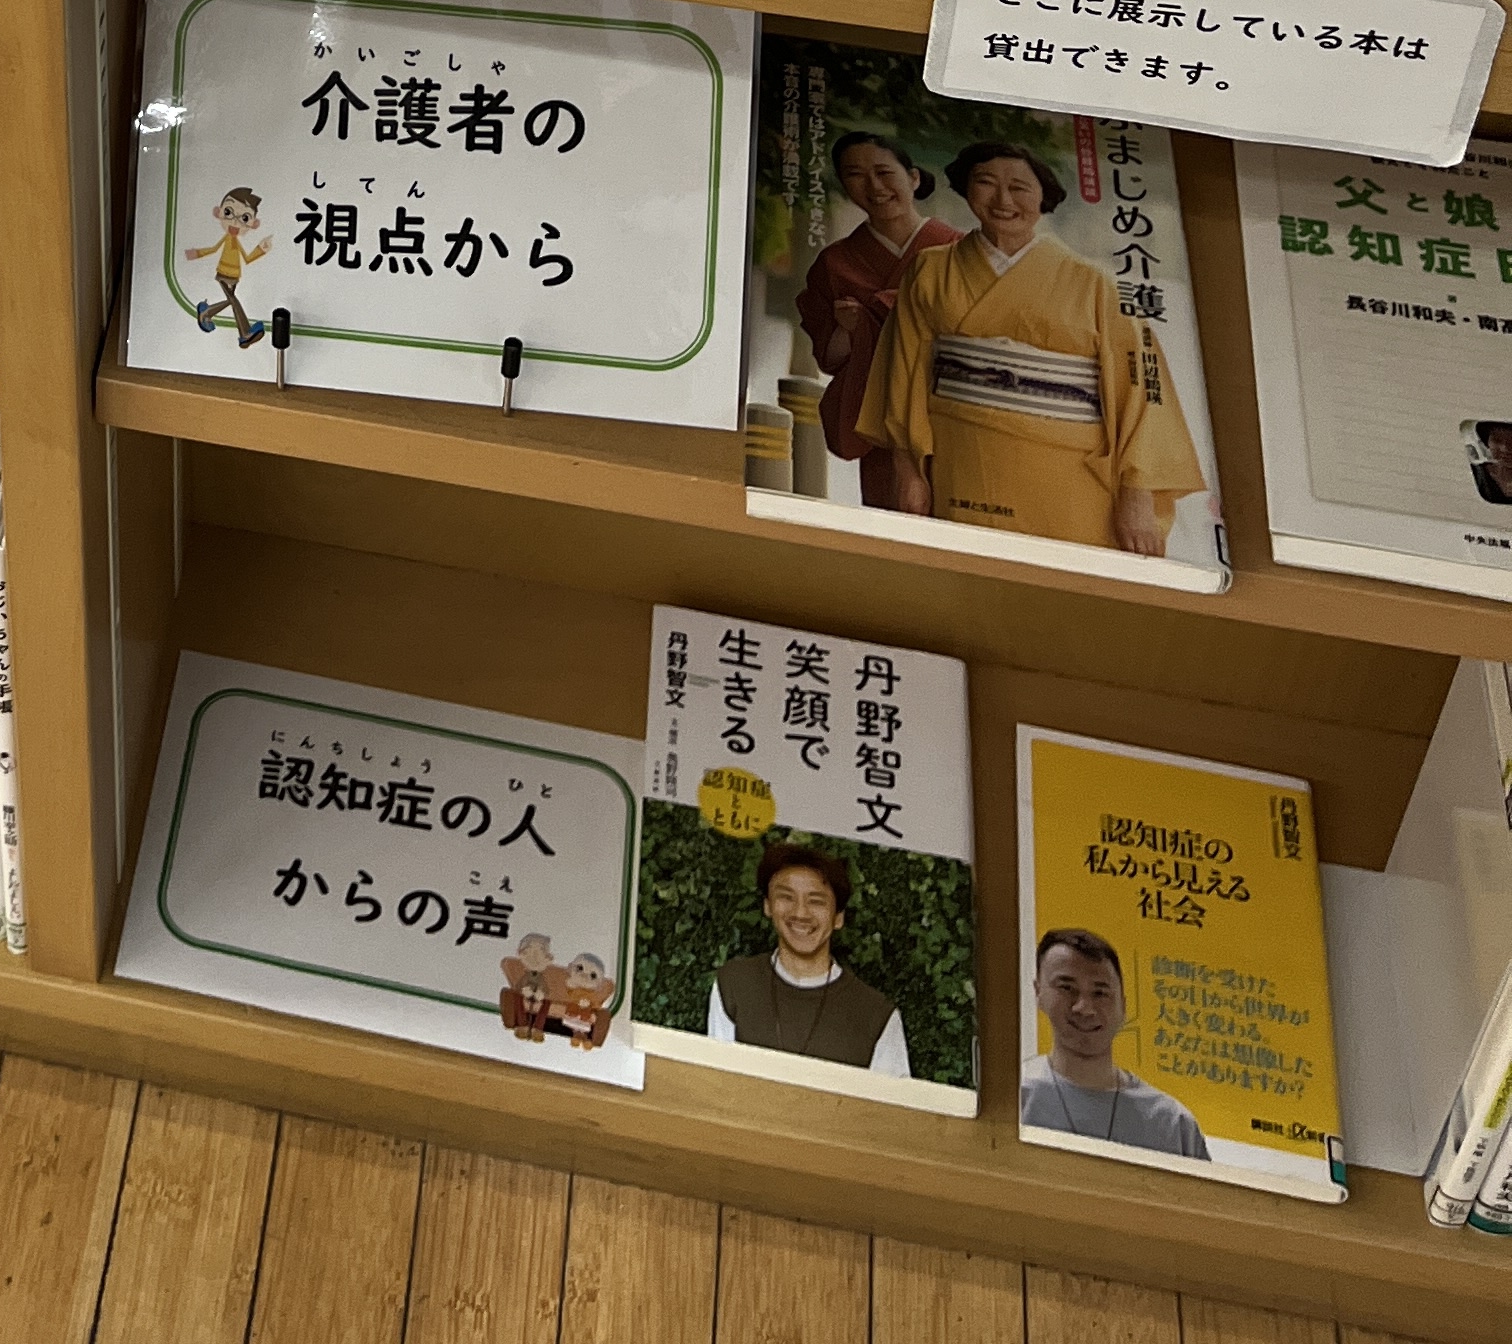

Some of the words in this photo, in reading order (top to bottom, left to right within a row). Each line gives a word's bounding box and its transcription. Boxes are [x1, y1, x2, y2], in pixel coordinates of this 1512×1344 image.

[982, 32, 1234, 93] 貸出できます。
[301, 69, 586, 155] 介護者の
[293, 198, 575, 288] 視点から
[719, 629, 763, 756] 生きる
[783, 639, 831, 771] 笑顔で
[855, 654, 904, 839] 丹野智文
[258, 750, 557, 858] 認知症の人
[1099, 813, 1234, 865] 認知症の
[272, 859, 516, 947] からの声
[1085, 844, 1250, 903] 私から見える
[1139, 886, 1206, 928] 社会
